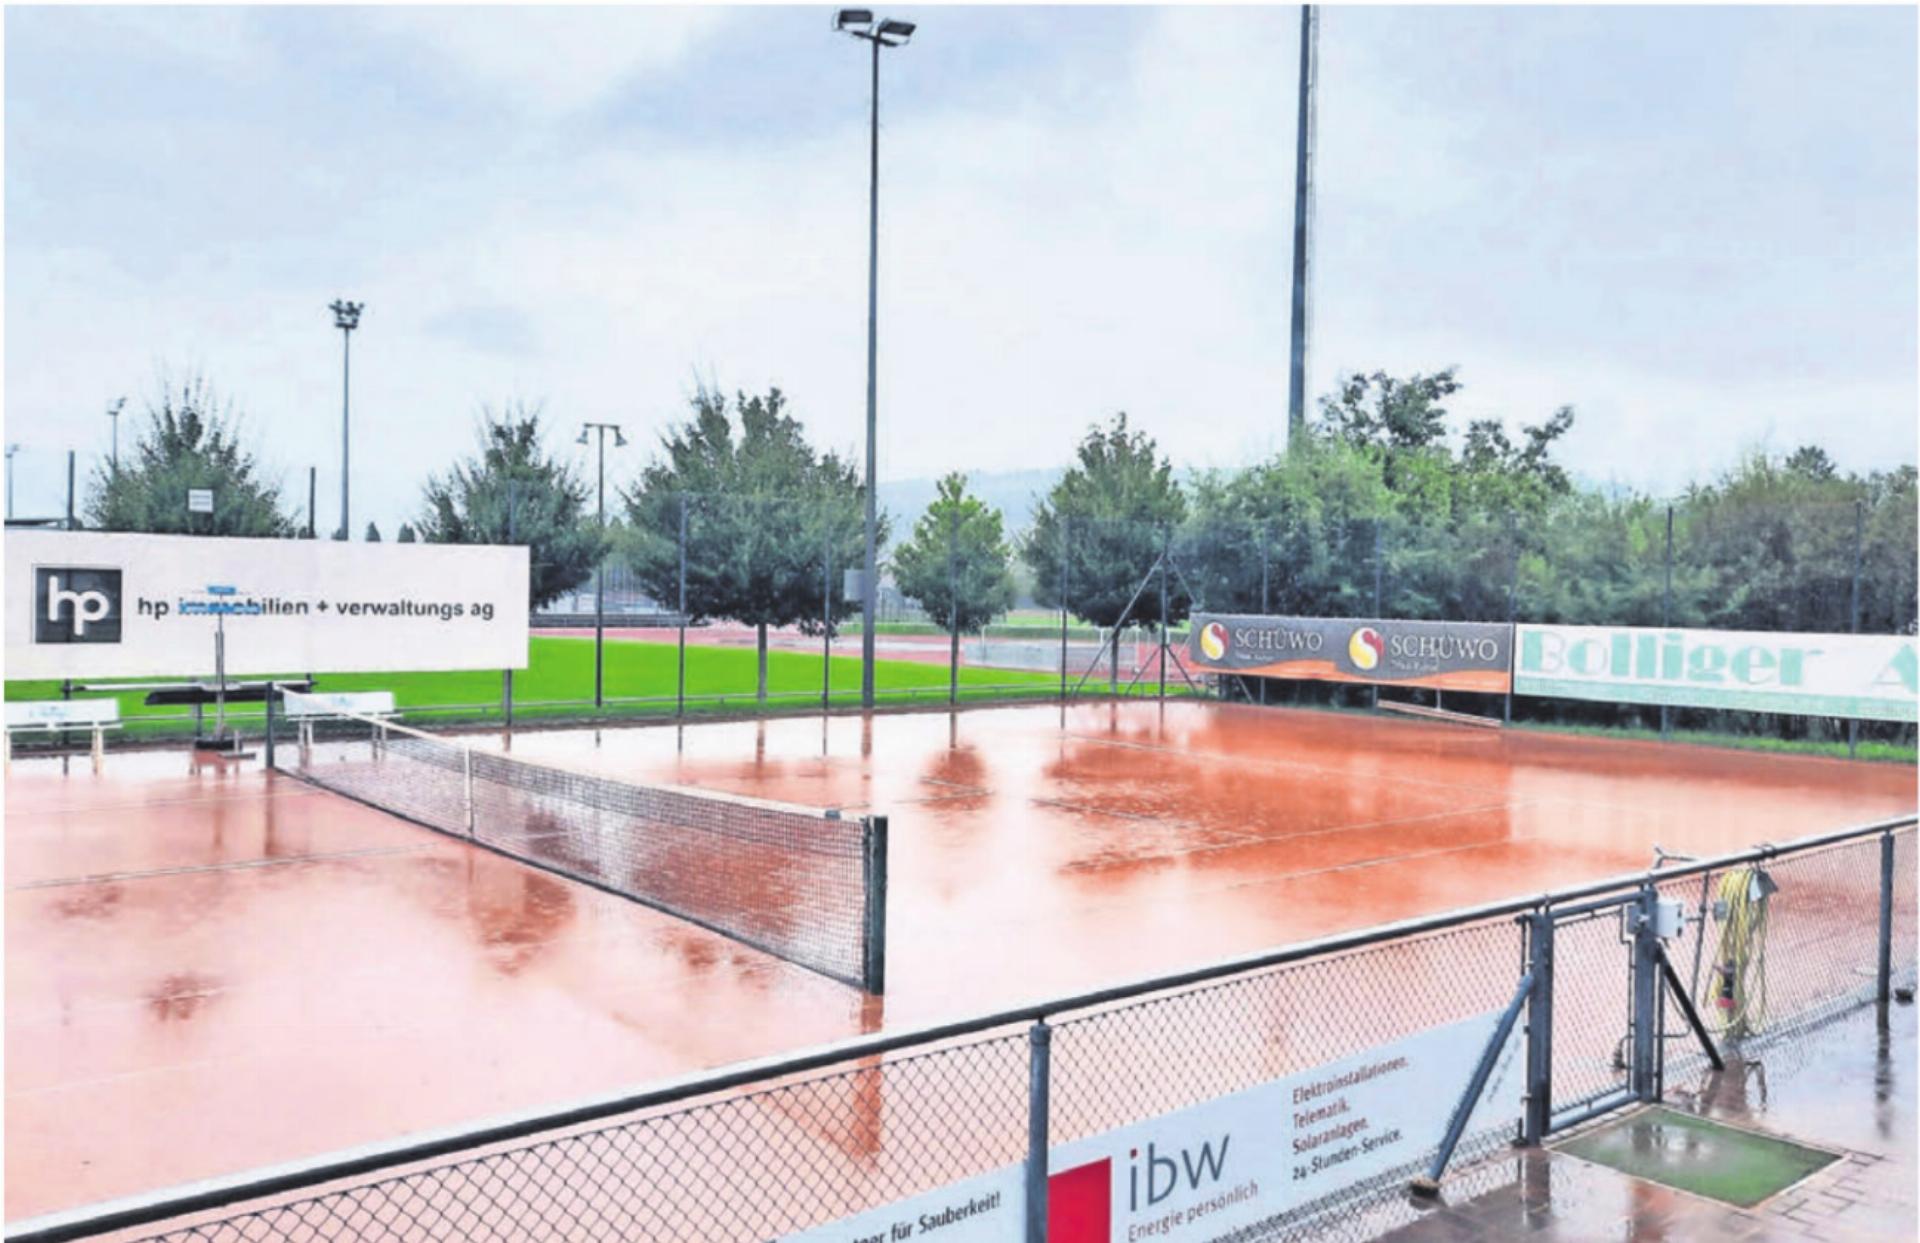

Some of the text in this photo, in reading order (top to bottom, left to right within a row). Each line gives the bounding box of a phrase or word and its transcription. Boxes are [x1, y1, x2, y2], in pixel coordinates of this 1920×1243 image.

[48, 575, 110, 636] hp
[138, 597, 169, 621] hp
[316, 600, 329, 613] +
[336, 599, 464, 621] verwaltungs
[470, 602, 494, 621] ag
[1235, 627, 1323, 651] SCHÜWO
[1391, 633, 1498, 661] SCHÜWO
[1522, 631, 1825, 686] Bolliger
[1292, 1117, 1369, 1155] Solaranlagen.
[1130, 1133, 1230, 1212] ibw
[891, 1221, 914, 1243] für
[918, 1191, 1001, 1234] Sauberkeit!
[1128, 1179, 1258, 1243] Energie persönlich
